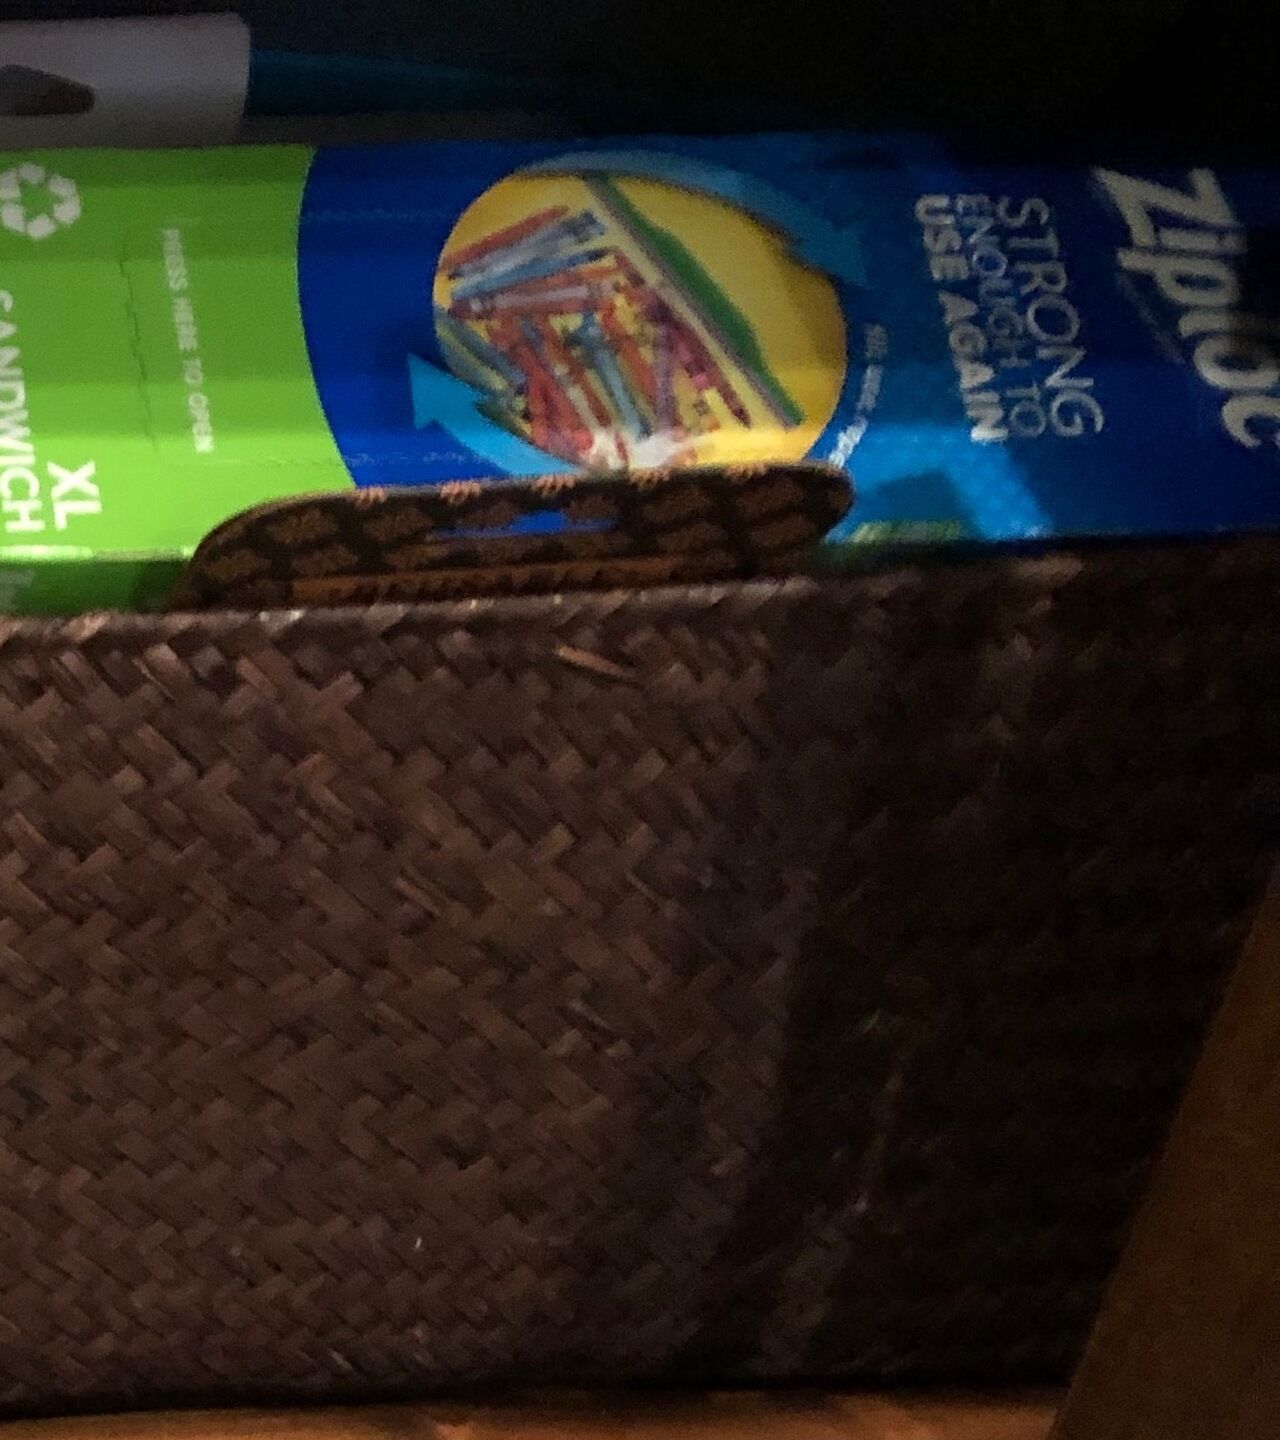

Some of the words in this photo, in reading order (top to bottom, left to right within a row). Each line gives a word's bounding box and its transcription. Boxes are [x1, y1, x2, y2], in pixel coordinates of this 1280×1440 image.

[182, 357, 204, 389] TO
[915, 194, 970, 281] USE
[943, 292, 1009, 444] AGAIN
[956, 194, 1032, 369] ENOUGH
[1006, 382, 1047, 438] TO
[996, 198, 1104, 438] STRONG
[47, 460, 102, 532] XL
[187, 394, 215, 455] OPEN
